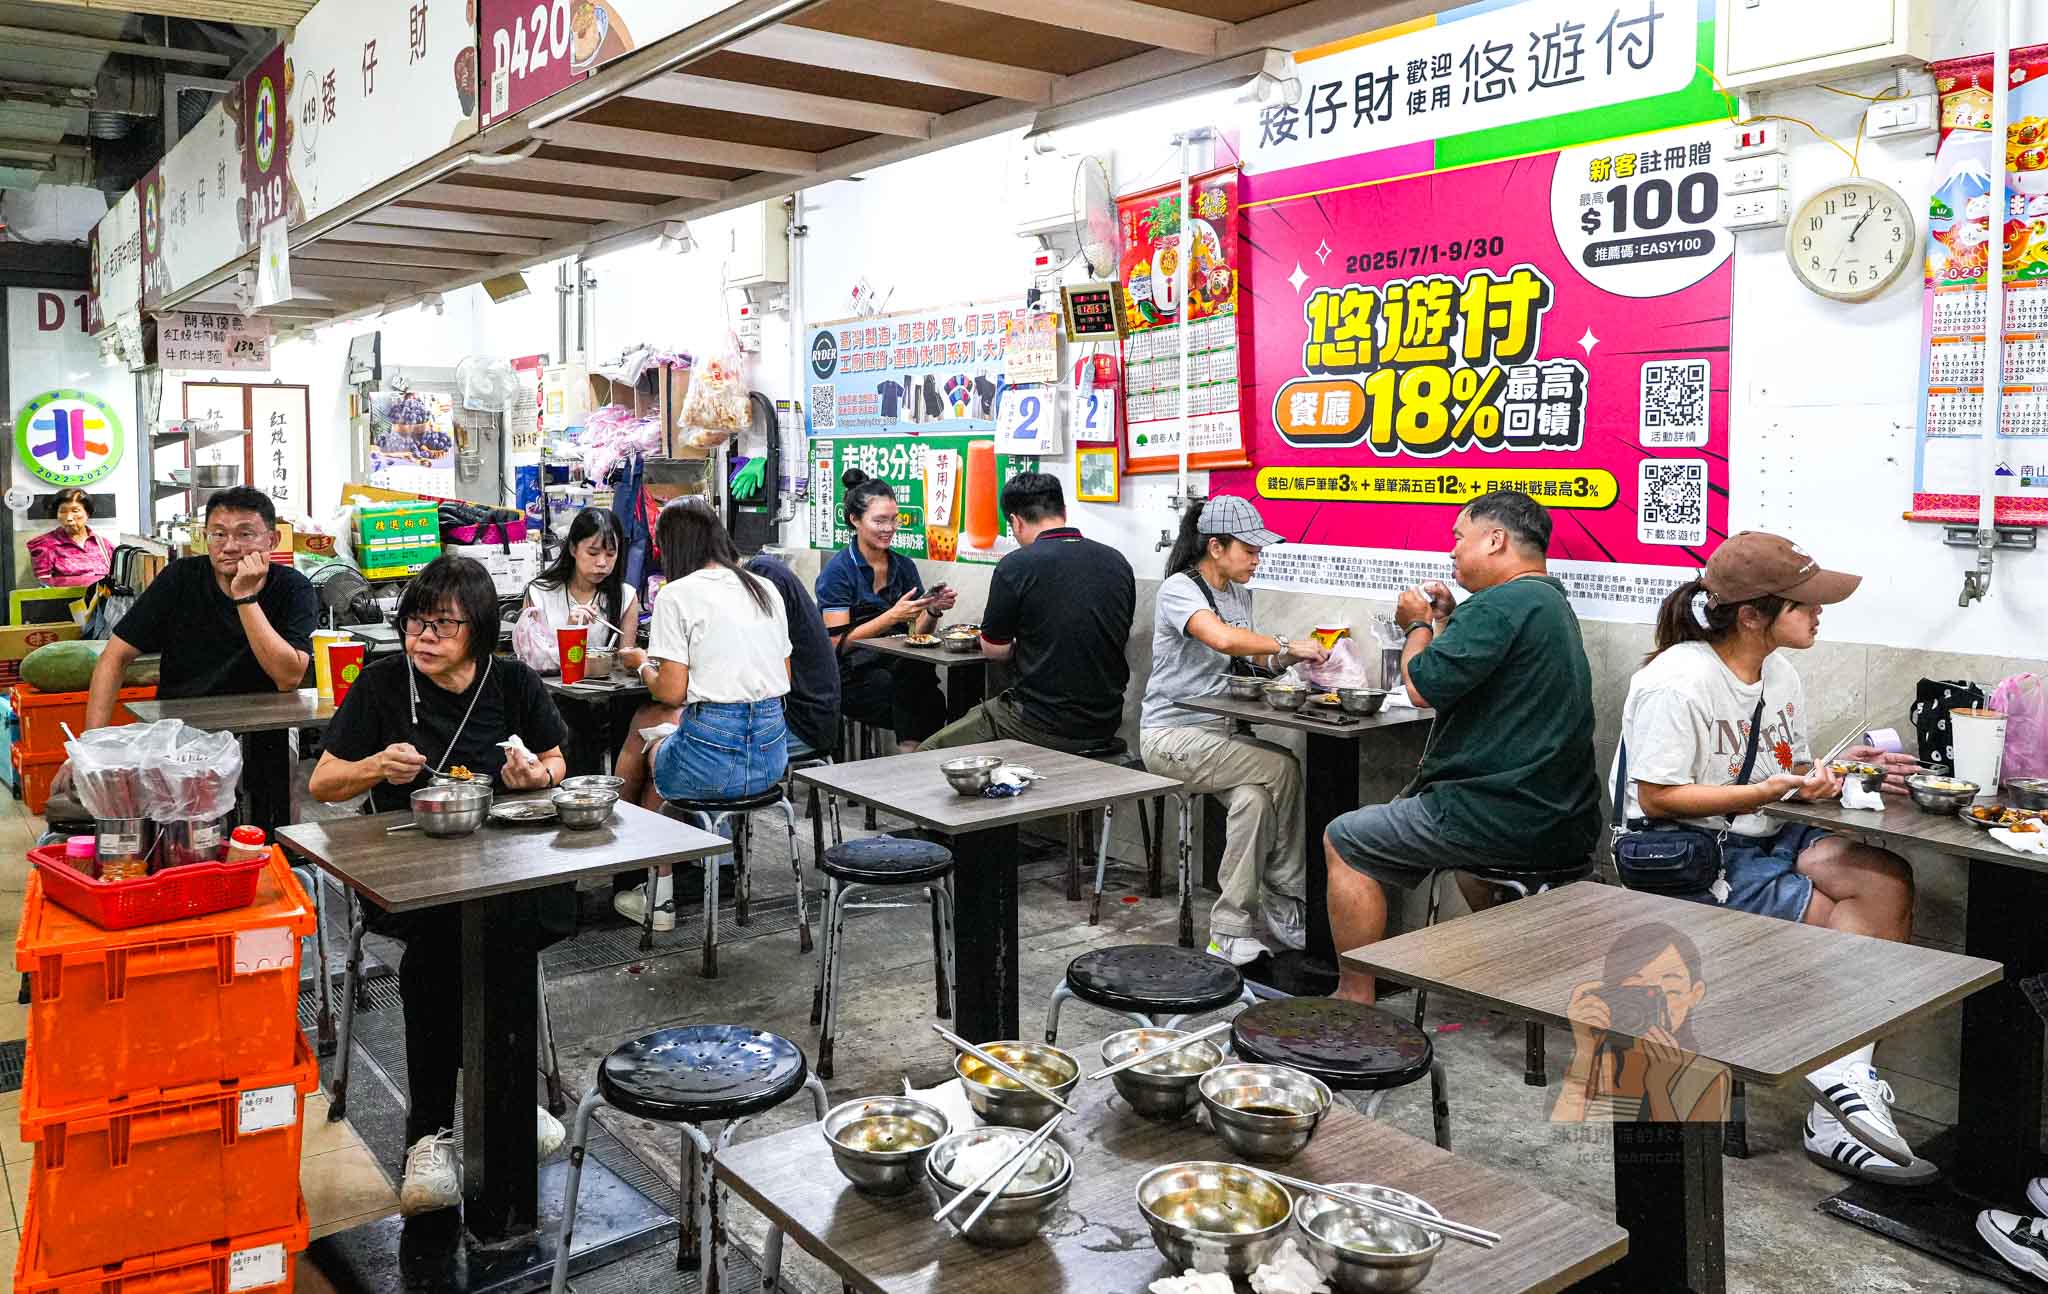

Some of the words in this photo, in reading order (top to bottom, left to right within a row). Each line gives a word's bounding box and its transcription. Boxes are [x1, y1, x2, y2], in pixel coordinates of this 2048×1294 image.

[493, 0, 571, 80] D420
[1459, 0, 1664, 105] 悠遊付
[321, 0, 428, 124] 矮仔財
[1406, 53, 1453, 86] 歡迎
[303, 97, 316, 127] 419
[1259, 66, 1400, 149] 矮仔財
[1406, 84, 1451, 116] 使用
[1589, 141, 1712, 183] 新客註冊贈
[1579, 191, 1604, 207] 最高
[1581, 172, 1719, 235] $100
[1825, 200, 1836, 215] 11
[1843, 192, 1857, 207] 12
[1883, 206, 1893, 221] 2
[1810, 216, 1823, 231] 10
[1892, 227, 1901, 241] 3
[1346, 237, 1505, 274] 2025/7/1-9/30
[1803, 236, 1812, 251] 9
[1885, 248, 1893, 264] 4
[1811, 256, 1820, 270] 8
[1829, 268, 1838, 283] 7
[1848, 271, 1858, 286] 6
[1869, 265, 1878, 280] 5
[1937, 266, 1984, 281] 2025
[1307, 274, 1541, 368] 悠遊付
[811, 349, 837, 362] RYDER
[1504, 364, 1576, 401] 最高
[1013, 396, 1041, 440] 2
[1086, 395, 1098, 429] 2
[1288, 394, 1351, 428] 餐廳
[1364, 364, 1502, 452] 18%
[1502, 401, 1574, 438] 回饋
[1650, 431, 1697, 443] 活動詳情
[935, 453, 948, 521] 禁用外食
[1643, 528, 1700, 542] 下載悠遊付
